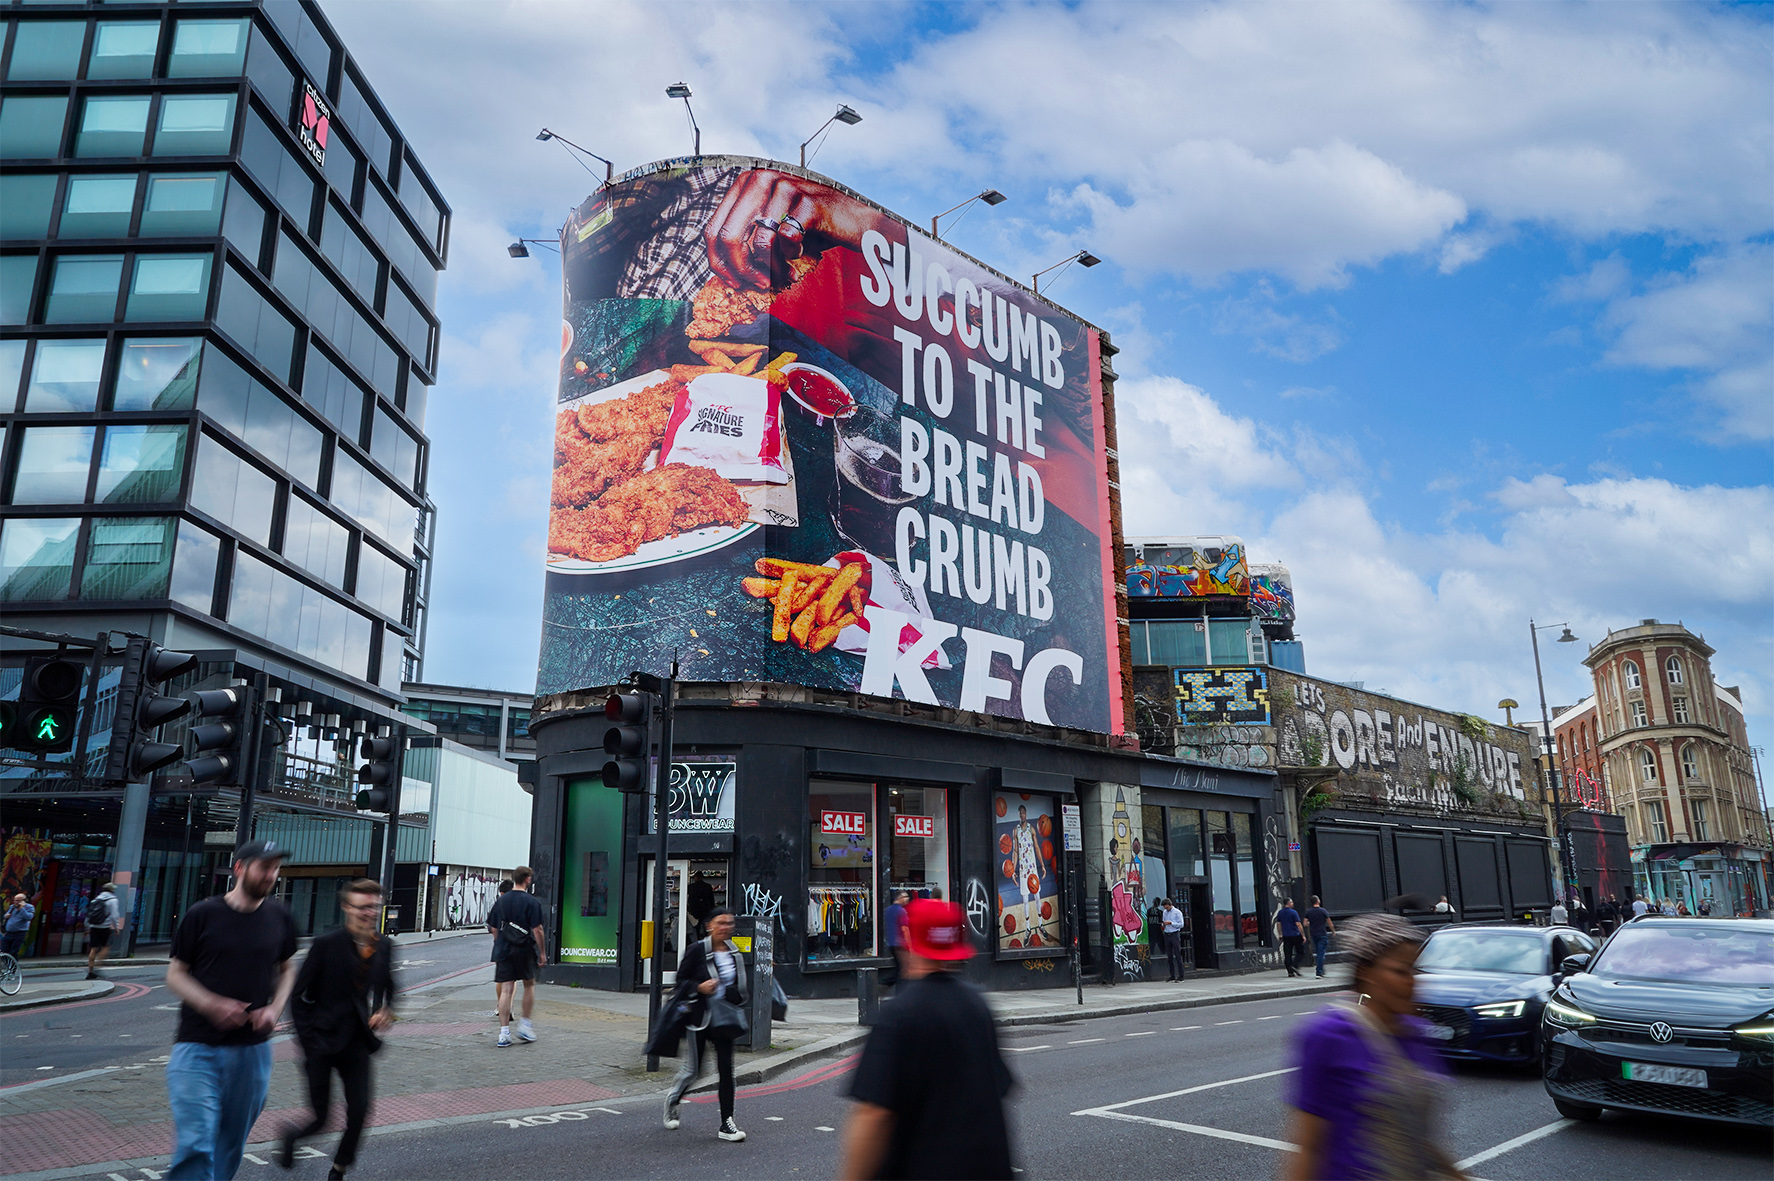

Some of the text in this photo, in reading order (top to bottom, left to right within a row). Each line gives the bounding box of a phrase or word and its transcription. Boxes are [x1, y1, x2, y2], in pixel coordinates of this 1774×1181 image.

[306, 84, 330, 119] citizen
[300, 124, 326, 167] hotel
[860, 230, 1065, 390] SUCCUMB
[894, 325, 1046, 460] TO THE
[901, 415, 1046, 535] BREAD
[895, 507, 1054, 621] CRUMB
[860, 605, 1084, 727] KFC
[1293, 681, 1326, 713] LETS
[1424, 720, 1525, 801] ENDURE
[823, 813, 863, 832] SALE
[896, 817, 932, 834] SALE
[560, 947, 618, 957] BOUNCEWEAR.CO
[492, 1107, 623, 1129] LOOK
